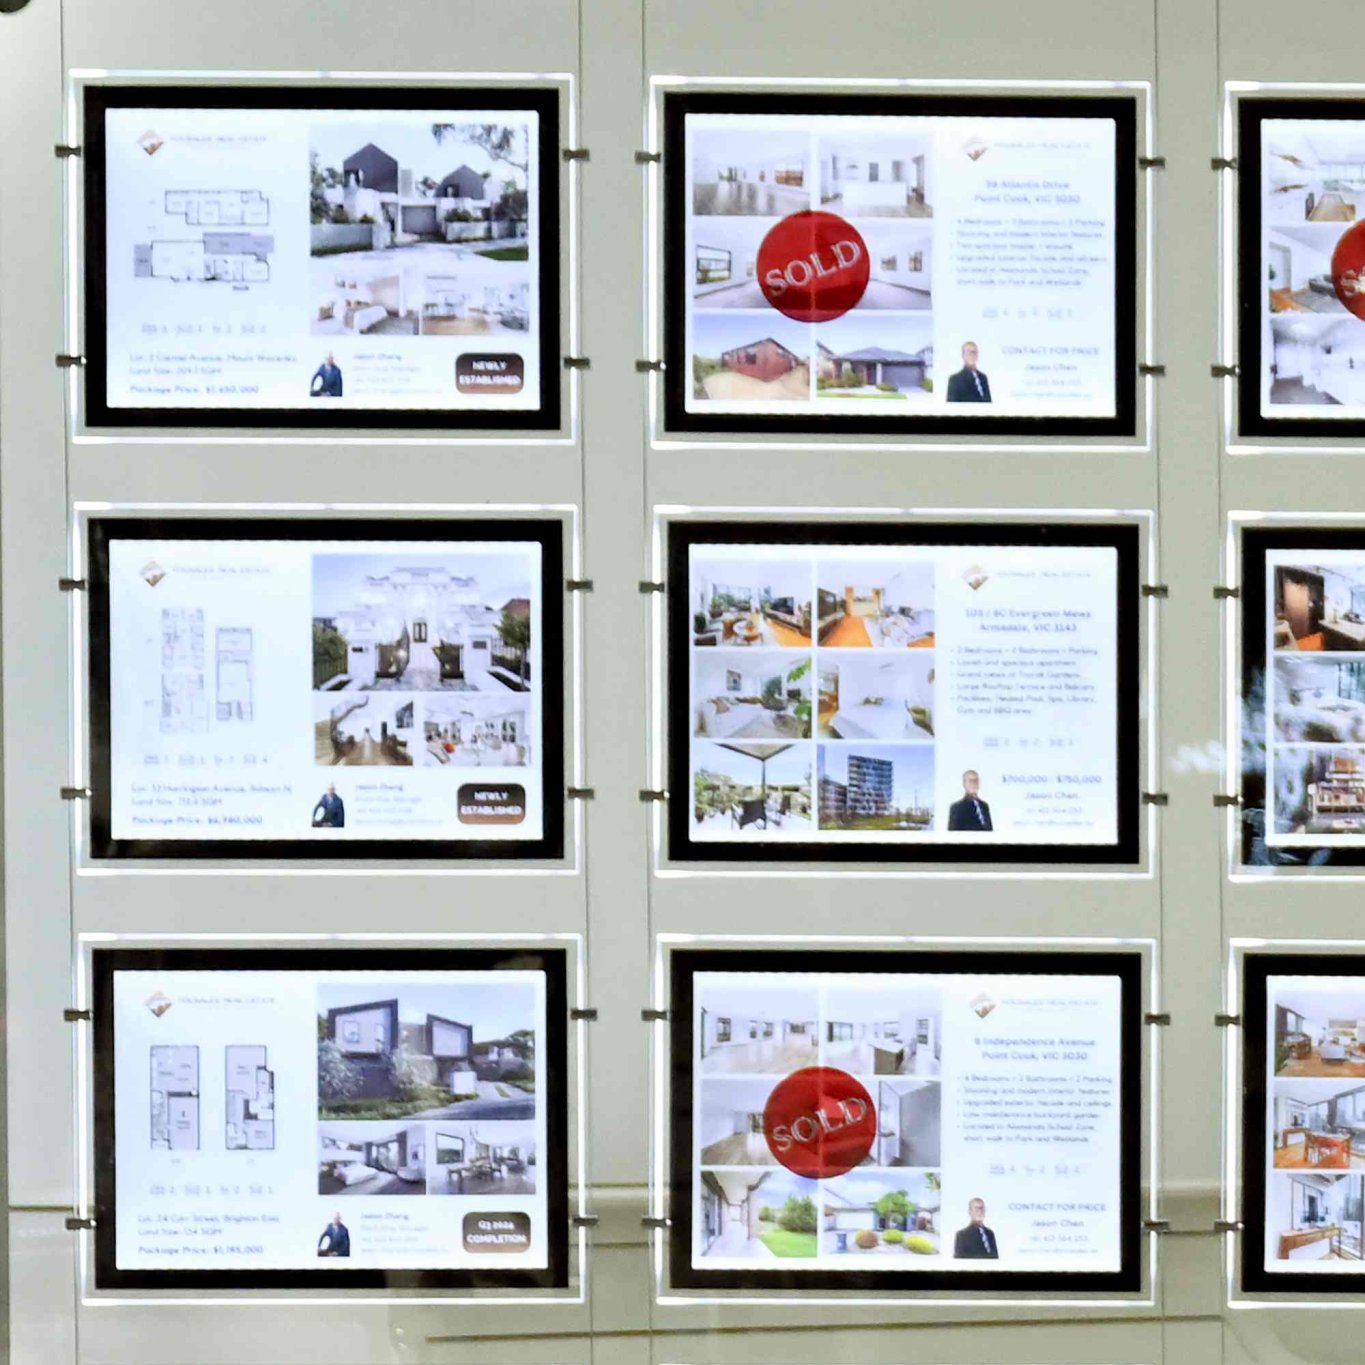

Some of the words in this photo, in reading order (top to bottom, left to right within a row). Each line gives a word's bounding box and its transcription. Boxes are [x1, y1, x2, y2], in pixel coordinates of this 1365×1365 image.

[764, 238, 862, 297] SOLD
[472, 361, 507, 372] NEWLY
[459, 376, 521, 387] ESTABLISHED
[474, 792, 508, 802] NEWLY
[458, 806, 523, 817] ESTABLISHED
[984, 1038, 1055, 1047] Independence
[982, 1052, 1008, 1060] Point
[1011, 1052, 1041, 1061] Cook,
[1043, 1051, 1059, 1061] VIC
[1062, 1052, 1088, 1061] 3030
[772, 1097, 867, 1152] SOLD
[1009, 1203, 1054, 1211] CONTACT
[1057, 1203, 1076, 1211] FOR
[1078, 1203, 1106, 1212] PRICE
[1061, 1220, 1084, 1228] Chen
[467, 1234, 527, 1245] COMPLETION
